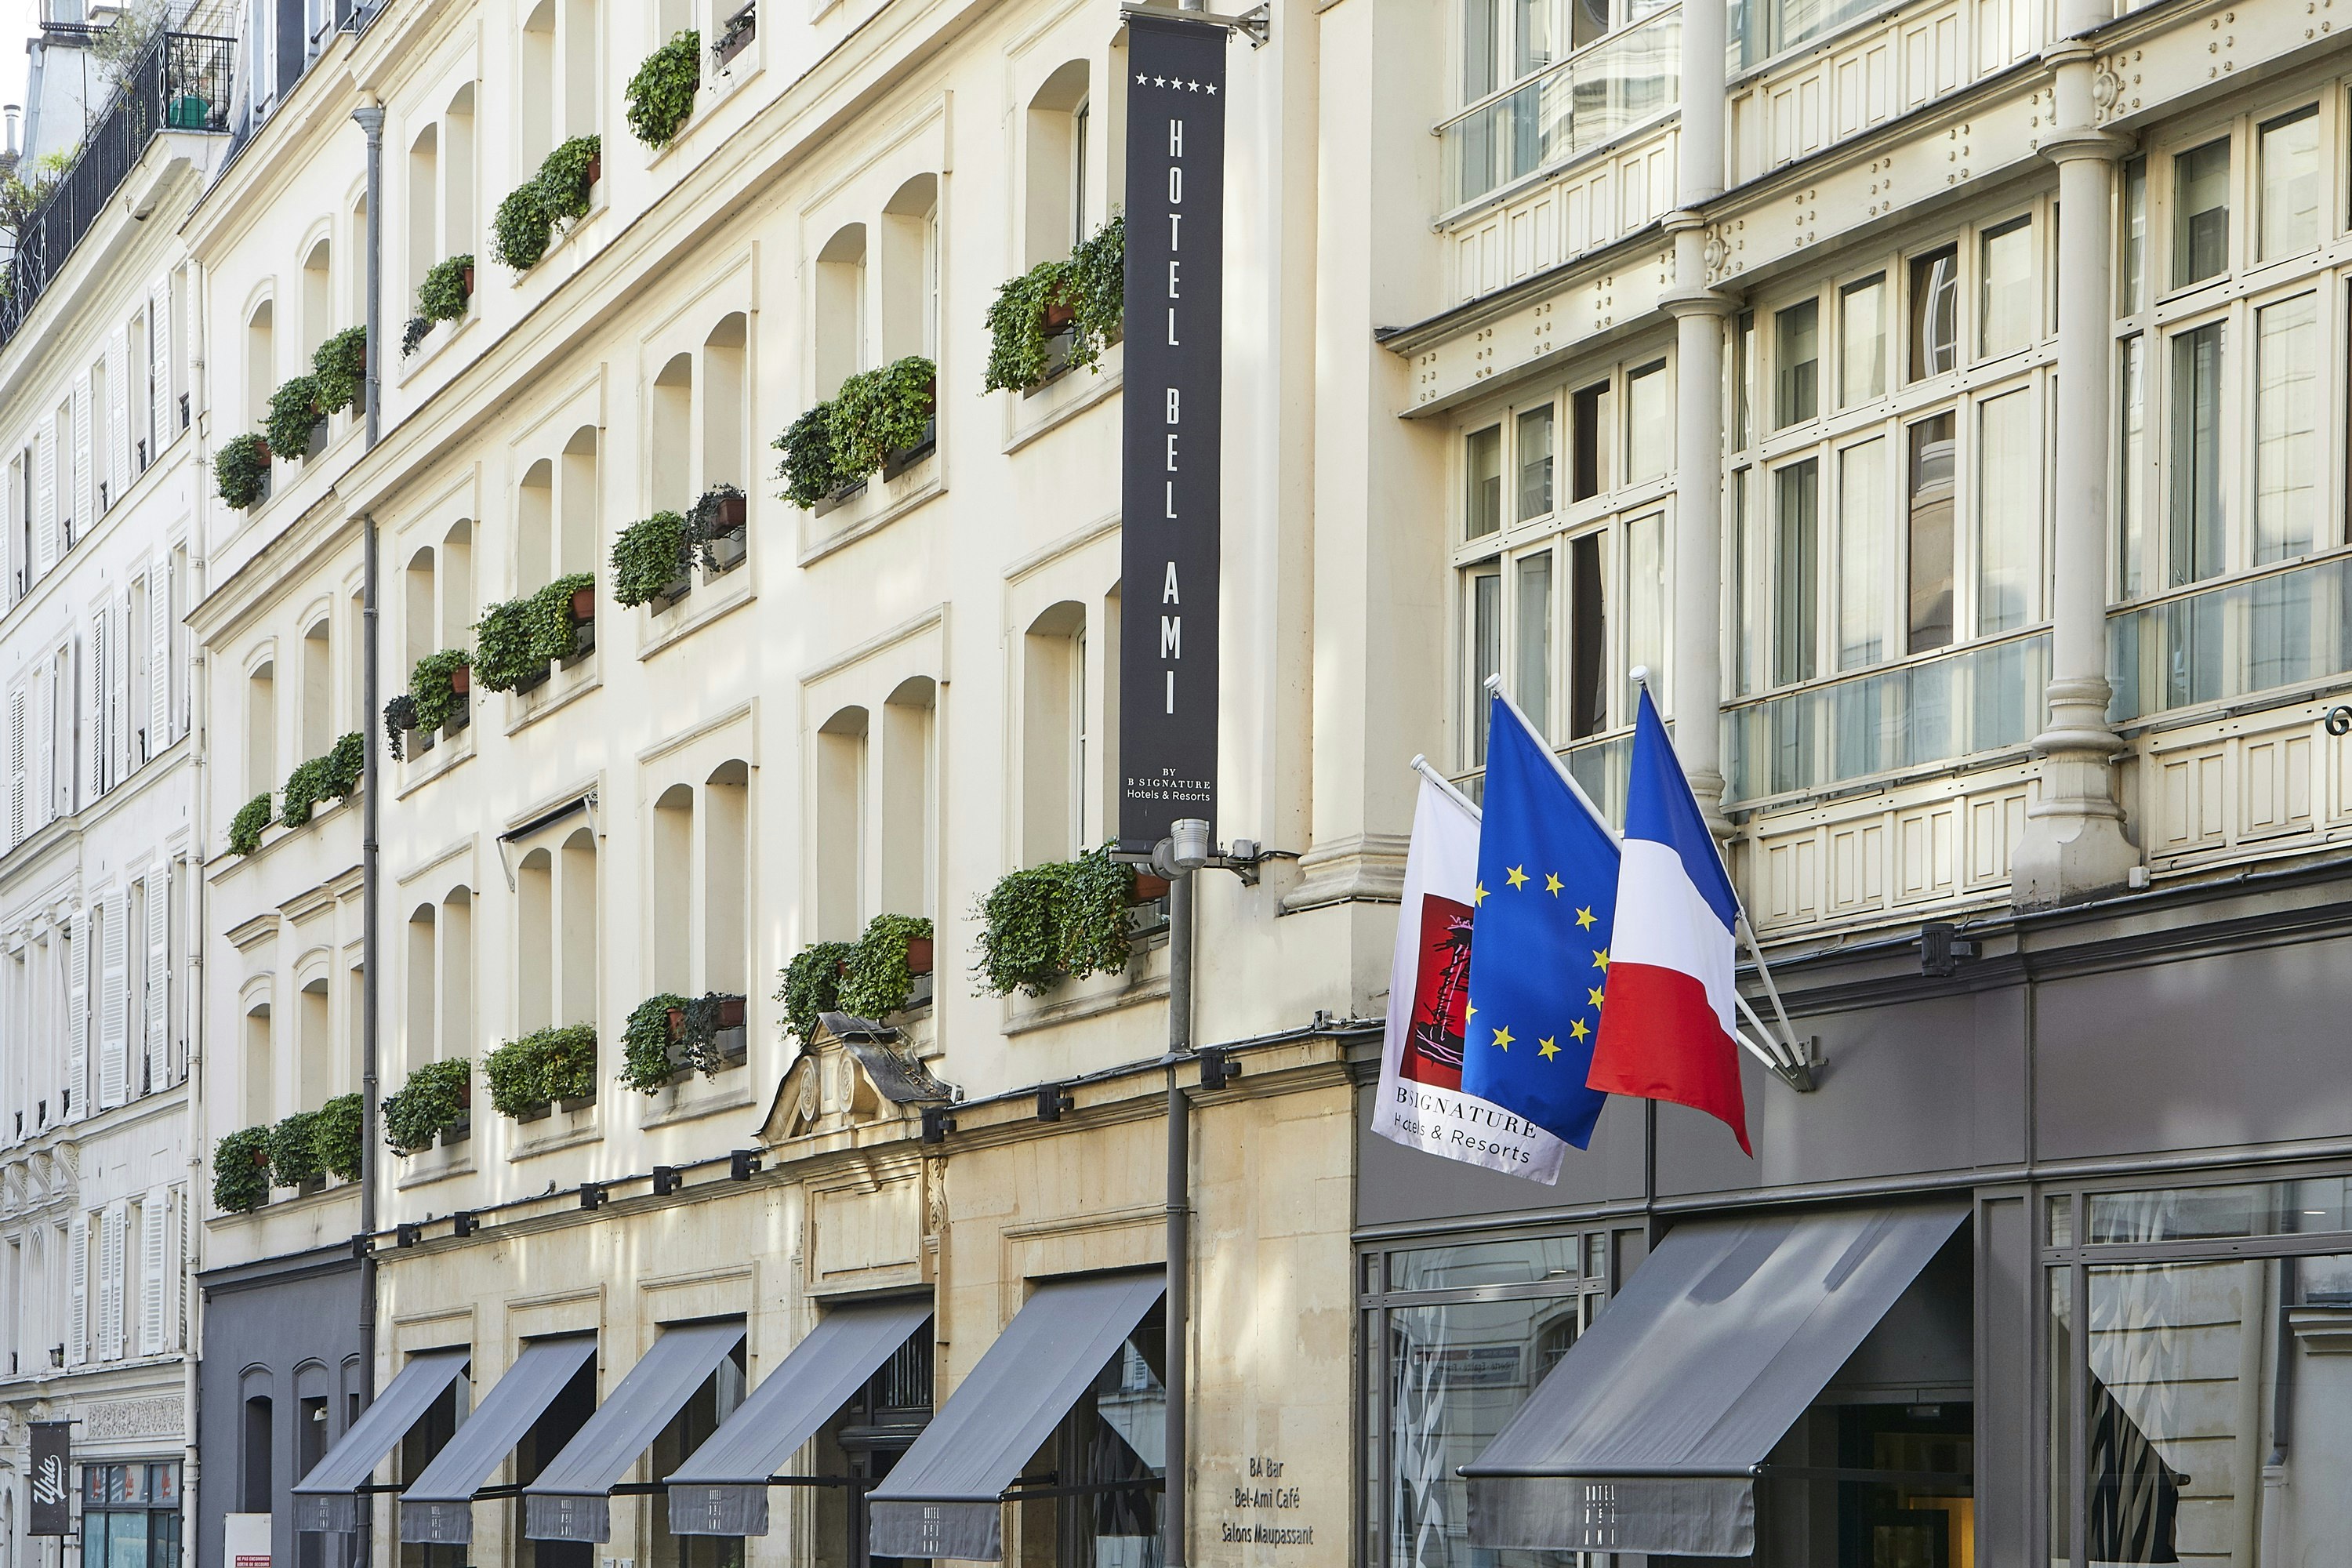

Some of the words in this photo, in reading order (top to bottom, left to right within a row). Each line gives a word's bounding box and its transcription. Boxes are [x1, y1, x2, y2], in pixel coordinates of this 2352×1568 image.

[1168, 118, 1183, 346] HOTEL
[1166, 387, 1181, 519] BEL
[1160, 561, 1181, 714] AMI
[1138, 779, 1210, 789] SIGNATURE
[1162, 768, 1176, 777] BY
[1127, 789, 1160, 800] Hotels
[1162, 790, 1170, 800] &
[1172, 791, 1210, 801] Resorts
[1394, 1112, 1425, 1136] Hotels
[1431, 1125, 1442, 1140] &
[1450, 1129, 1530, 1163] Resorts
[1250, 1457, 1264, 1478] BA
[1266, 1457, 1284, 1478] Bar
[1235, 1487, 1273, 1508] Bel-Ami
[1276, 1486, 1300, 1508] Café
[1221, 1522, 1252, 1544] Salons
[1254, 1523, 1314, 1549] Maupassant
